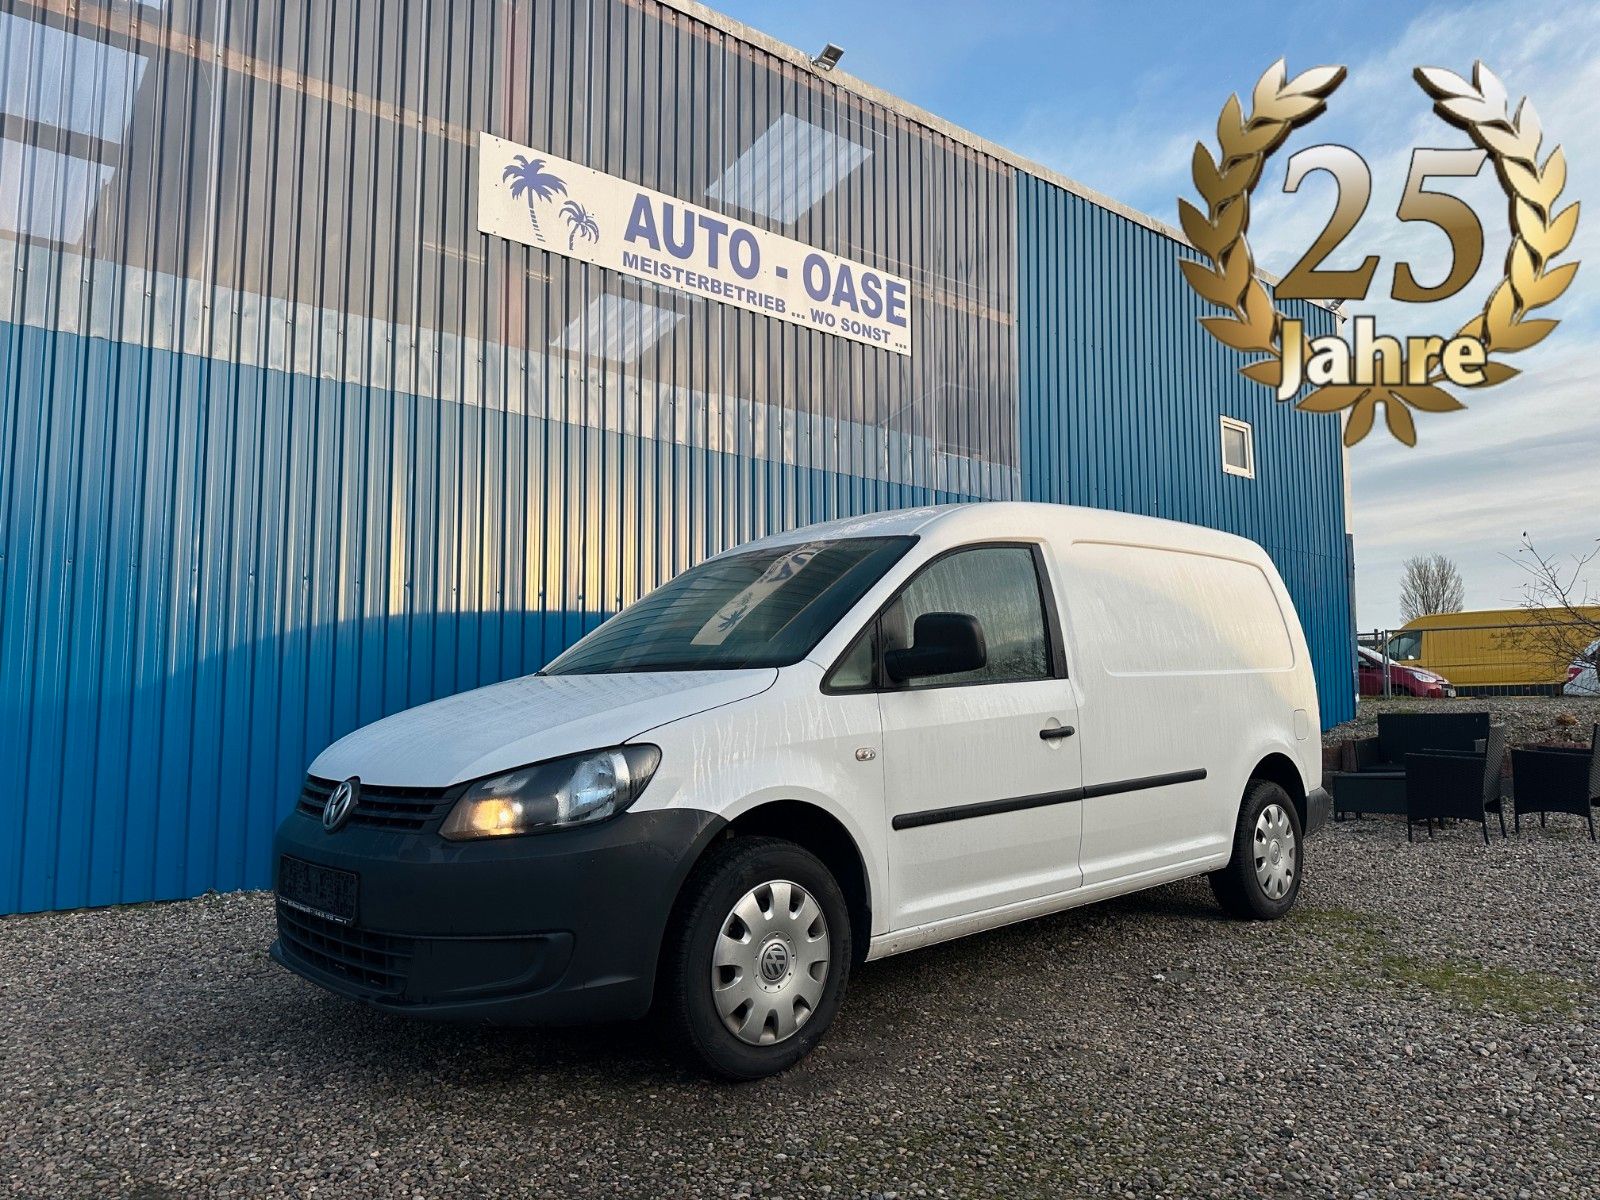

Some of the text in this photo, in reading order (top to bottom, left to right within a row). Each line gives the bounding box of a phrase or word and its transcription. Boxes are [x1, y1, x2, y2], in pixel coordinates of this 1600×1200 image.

[622, 250, 786, 314] MEISTERBETRIEB
[810, 307, 836, 327] WO
[840, 317, 891, 344] SONST
[623, 193, 760, 280] AUTO
[803, 253, 907, 328] OASE
